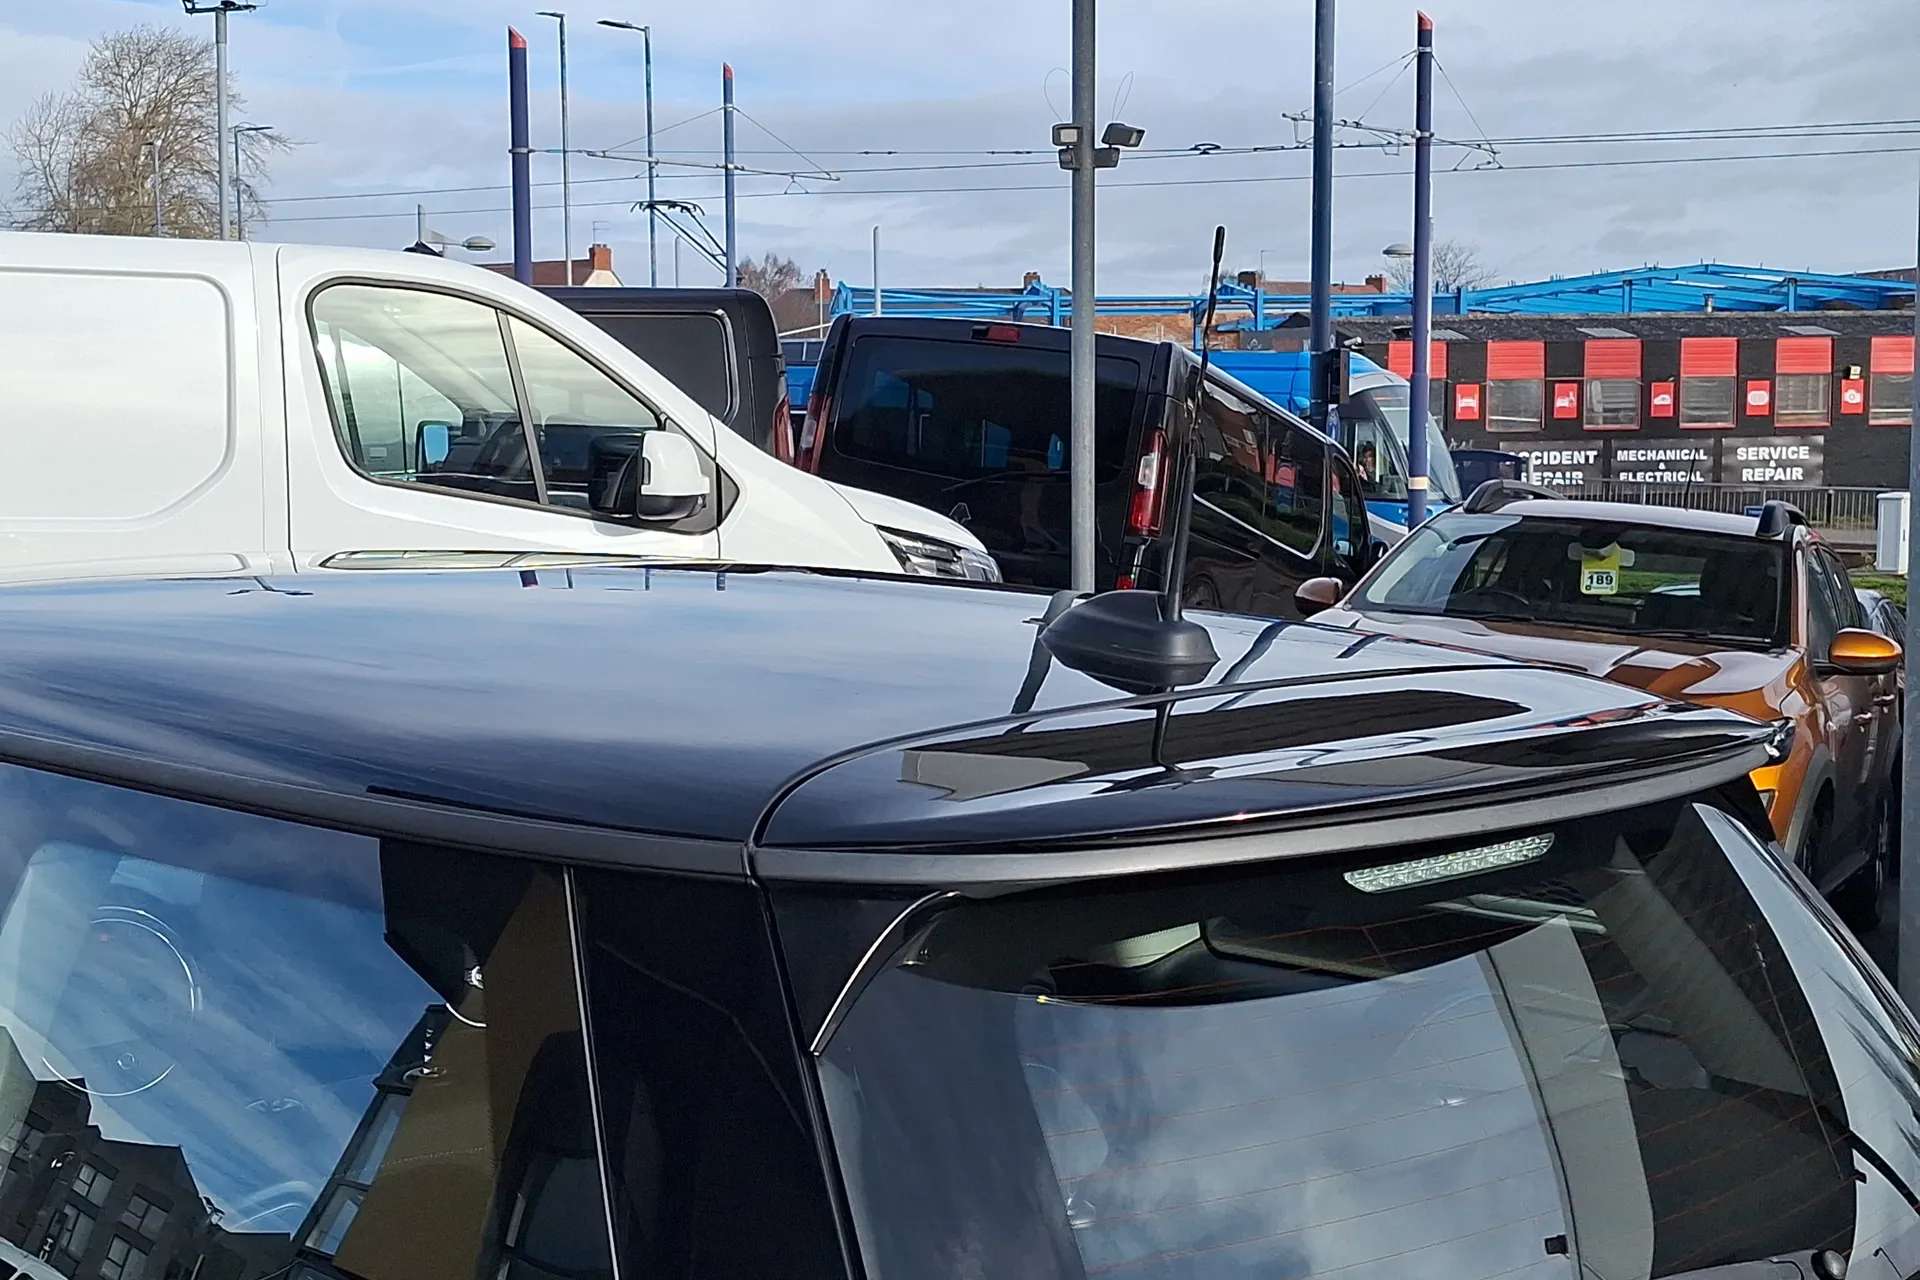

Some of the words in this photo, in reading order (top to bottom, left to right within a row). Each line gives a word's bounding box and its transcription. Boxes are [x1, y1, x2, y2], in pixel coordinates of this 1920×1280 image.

[1508, 450, 1598, 465] CIDENT
[1616, 448, 1708, 461] MECHANICAL
[1736, 446, 1810, 460] SERVICE
[1658, 462, 1666, 470] &
[1769, 460, 1777, 468] &
[1619, 471, 1705, 482] ELECTRICAL
[1742, 468, 1804, 481] REPAIR
[1587, 574, 1614, 585] 189
